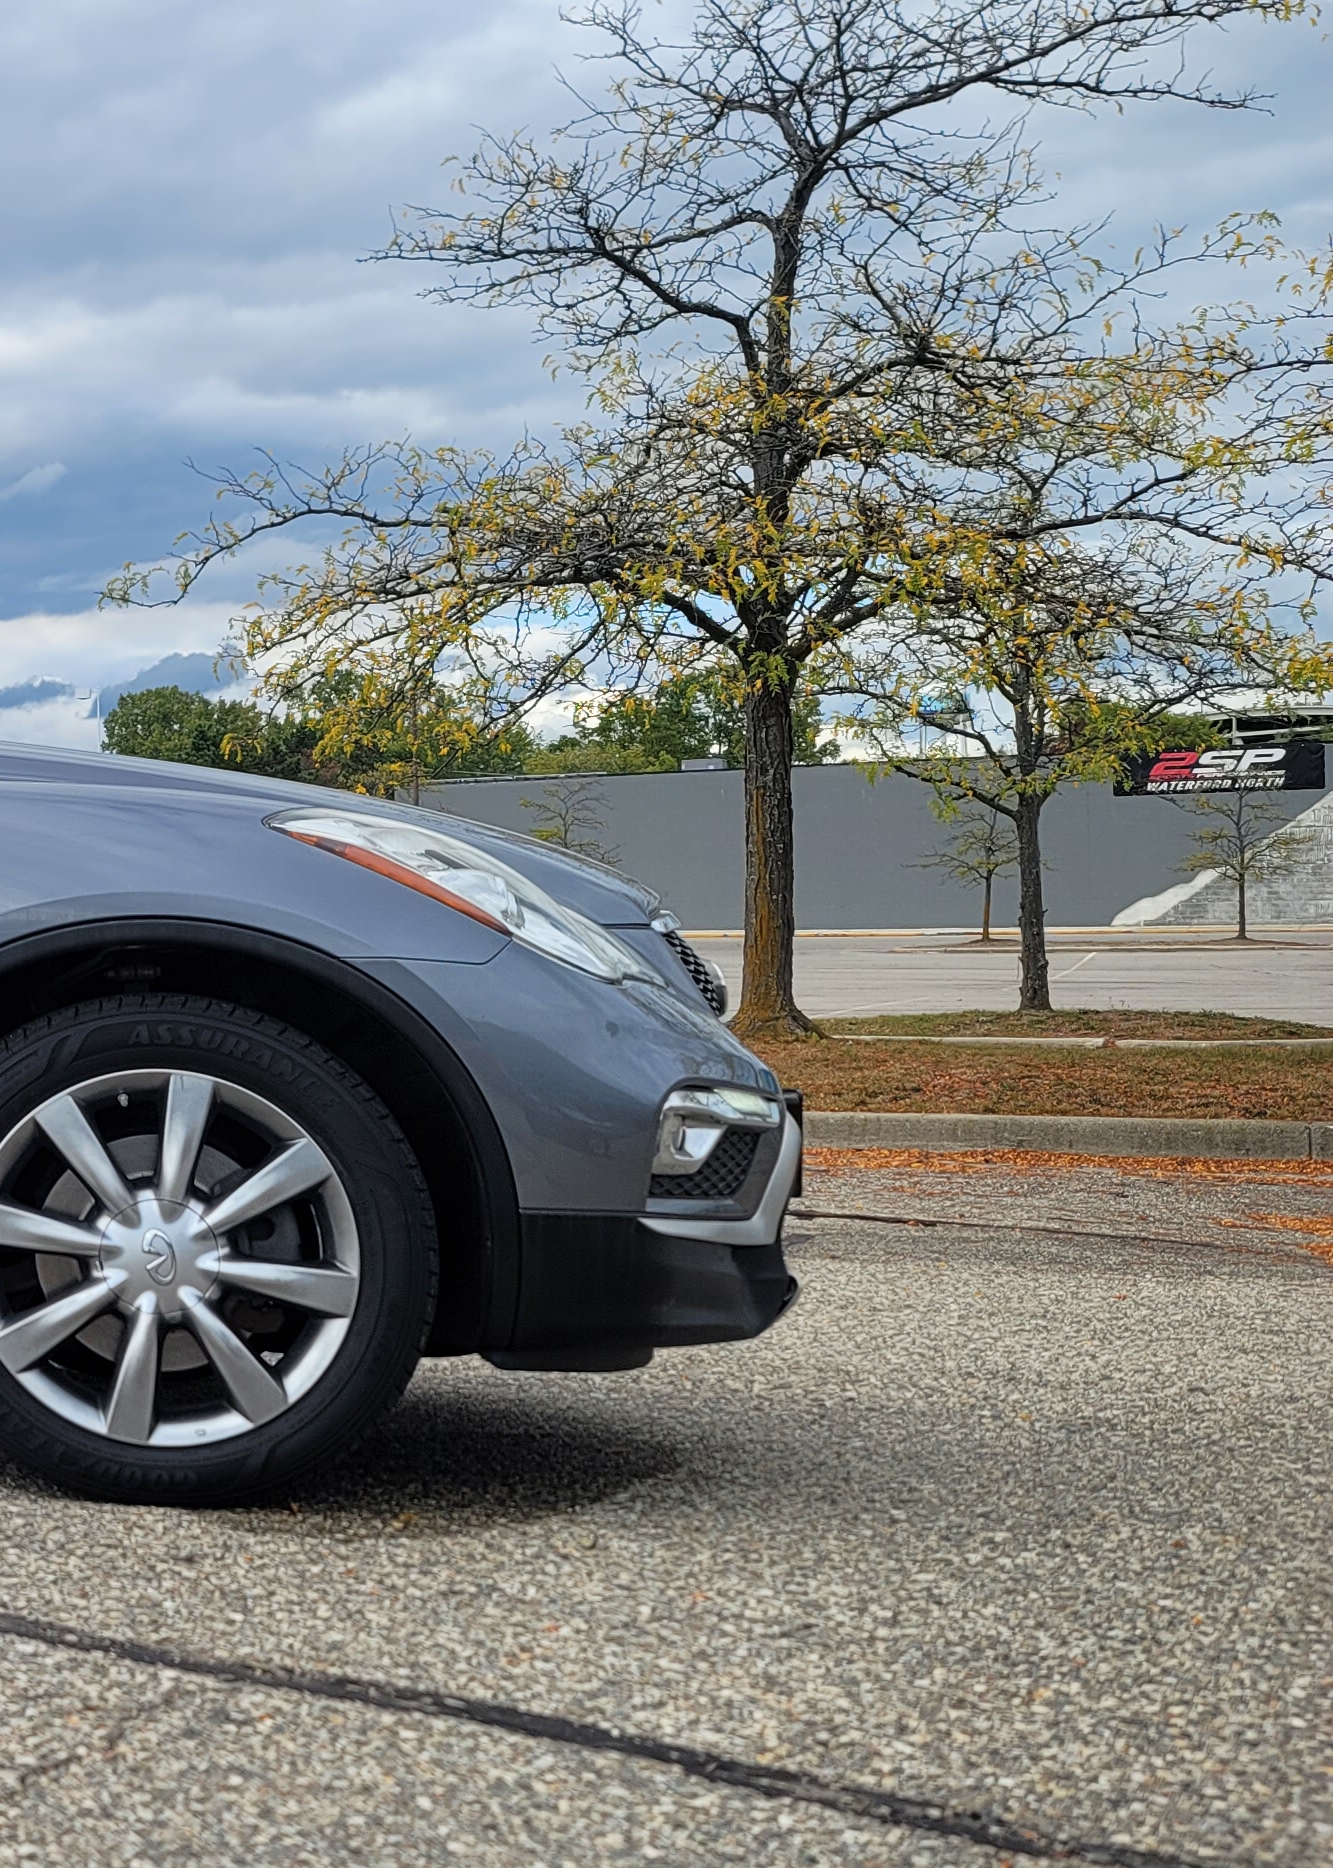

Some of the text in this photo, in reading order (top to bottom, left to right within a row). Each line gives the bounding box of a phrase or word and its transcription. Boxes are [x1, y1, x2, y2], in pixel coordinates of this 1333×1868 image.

[1148, 748, 1287, 776] 2SP
[1146, 777, 1285, 791] WATERFORD NORTH
